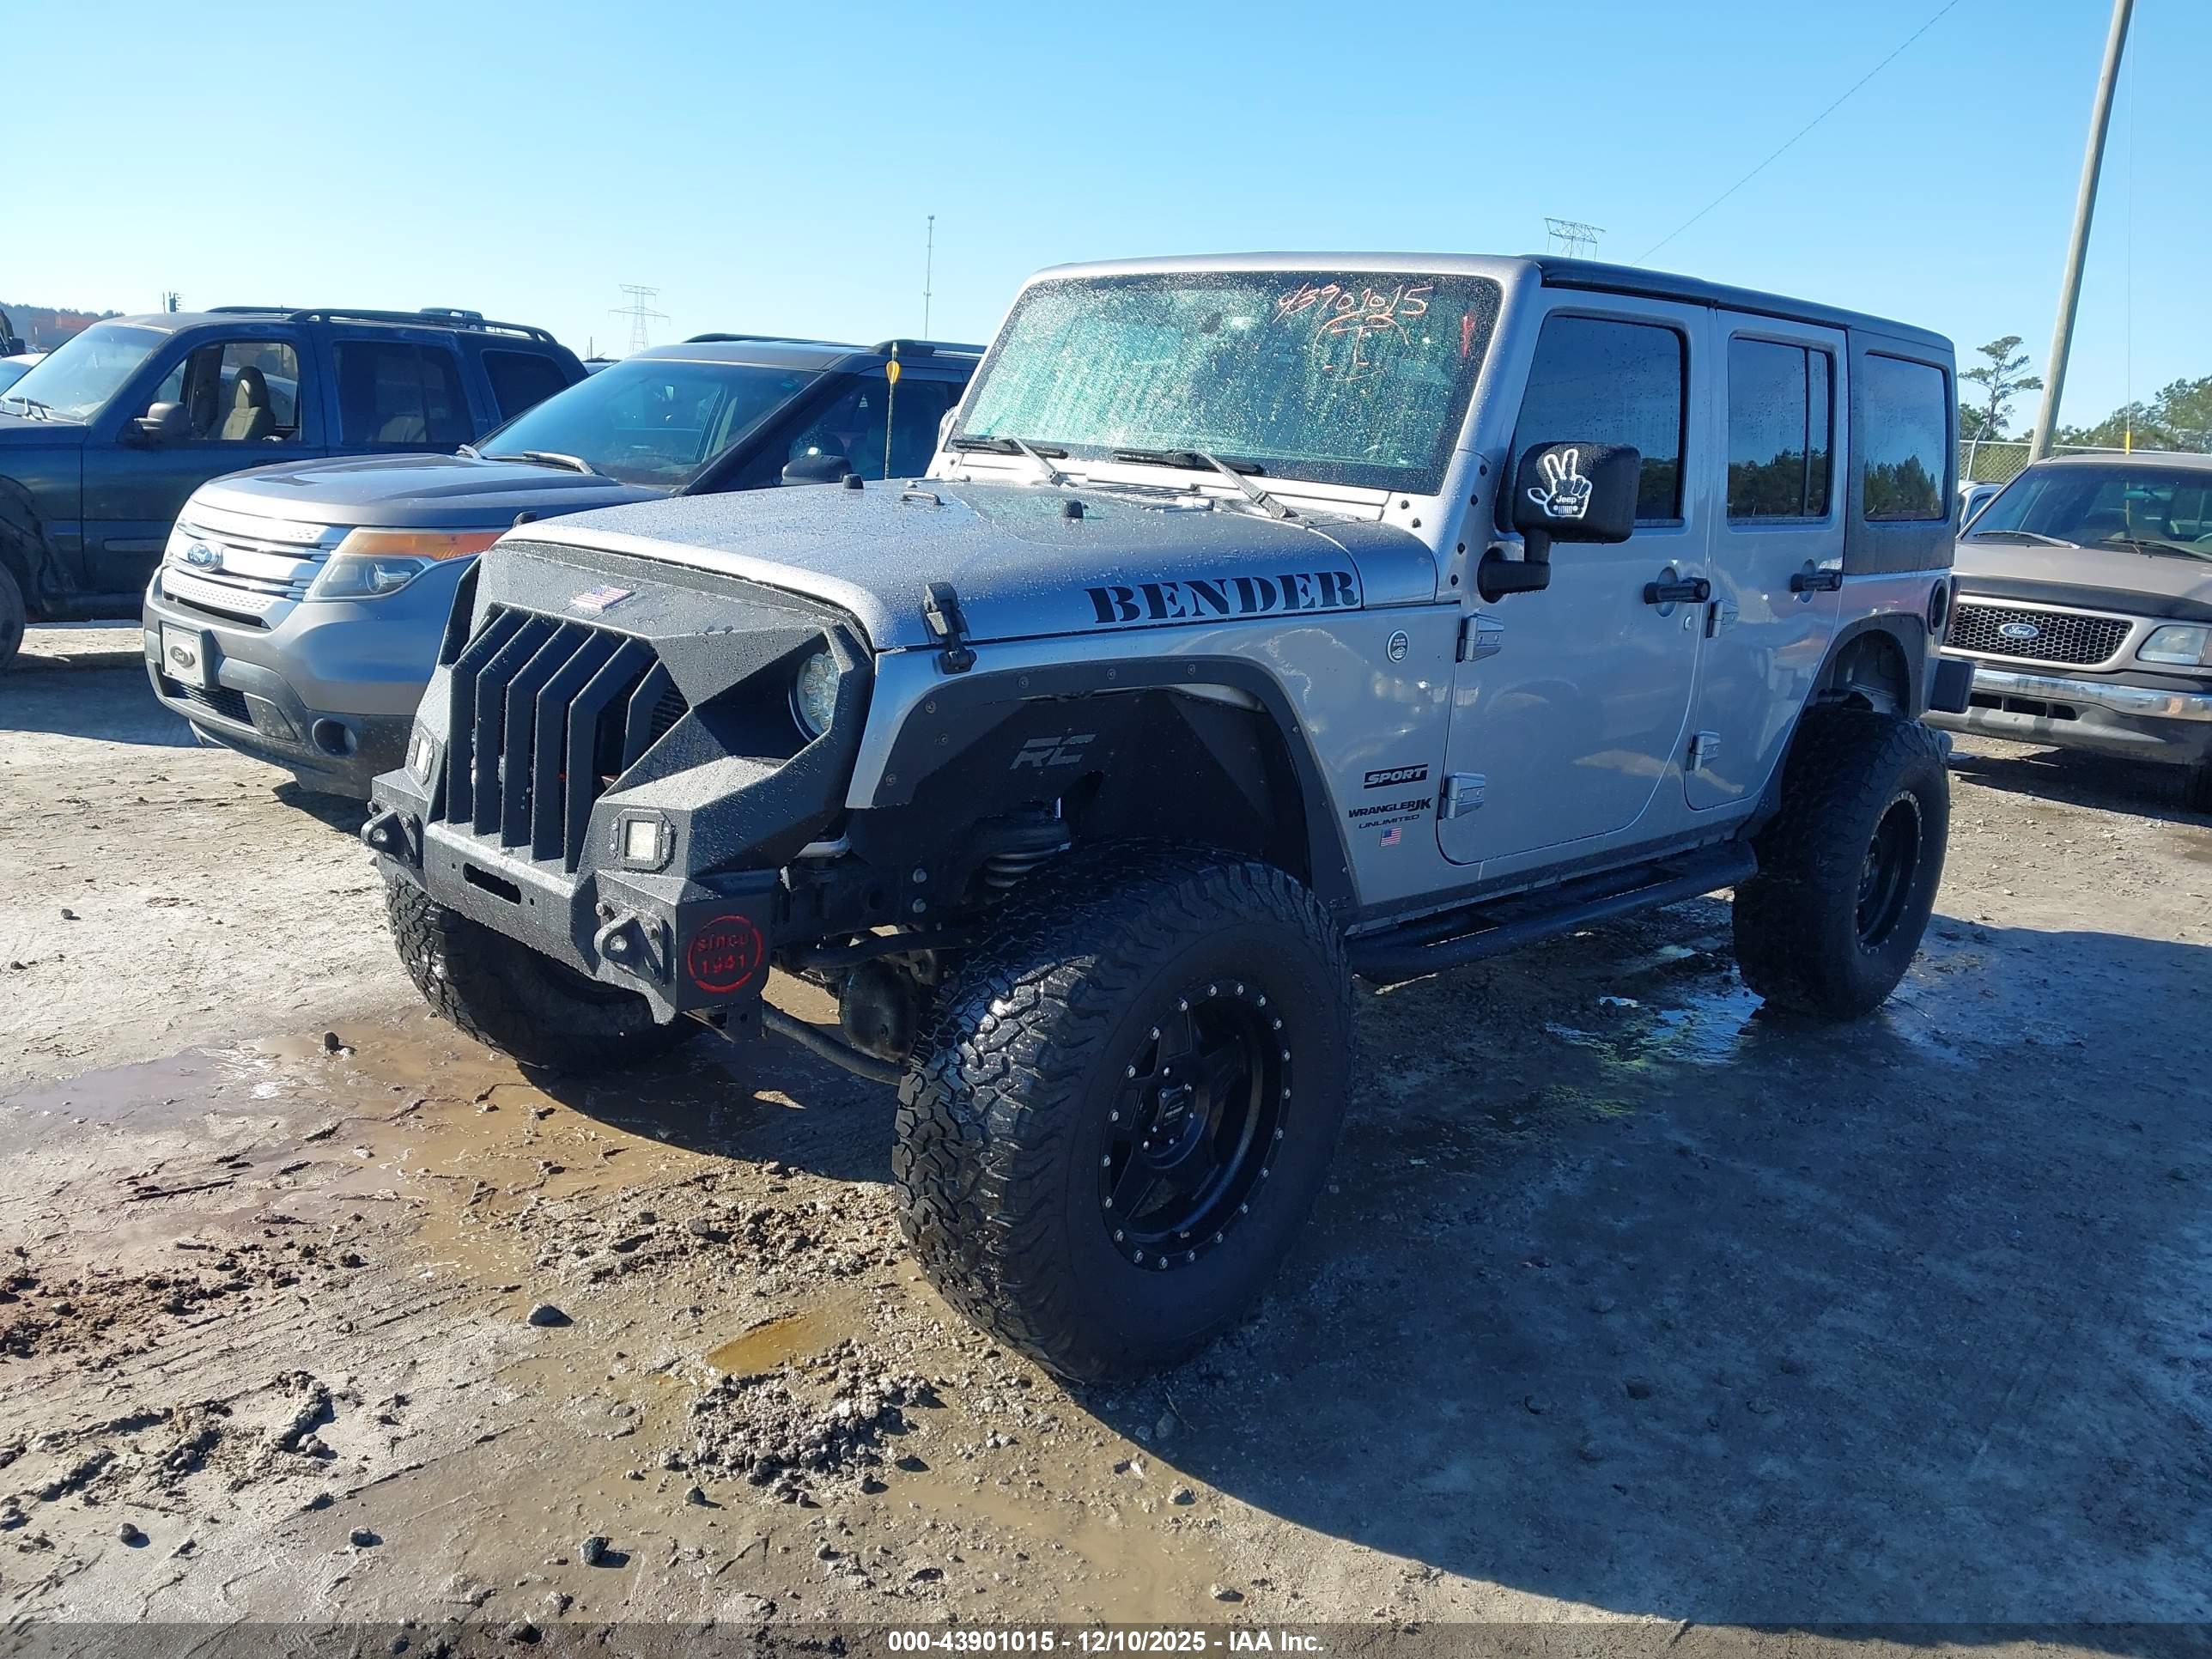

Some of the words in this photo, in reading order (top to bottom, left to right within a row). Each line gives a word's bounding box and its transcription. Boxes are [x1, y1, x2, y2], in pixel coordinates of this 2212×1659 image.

[1273, 282, 1434, 324] 43901015
[1555, 495, 1577, 505] Jeep
[1084, 570, 1360, 624] BENDER
[1367, 766, 1429, 785] SPORT
[1358, 813, 1420, 830] UNLIMITED
